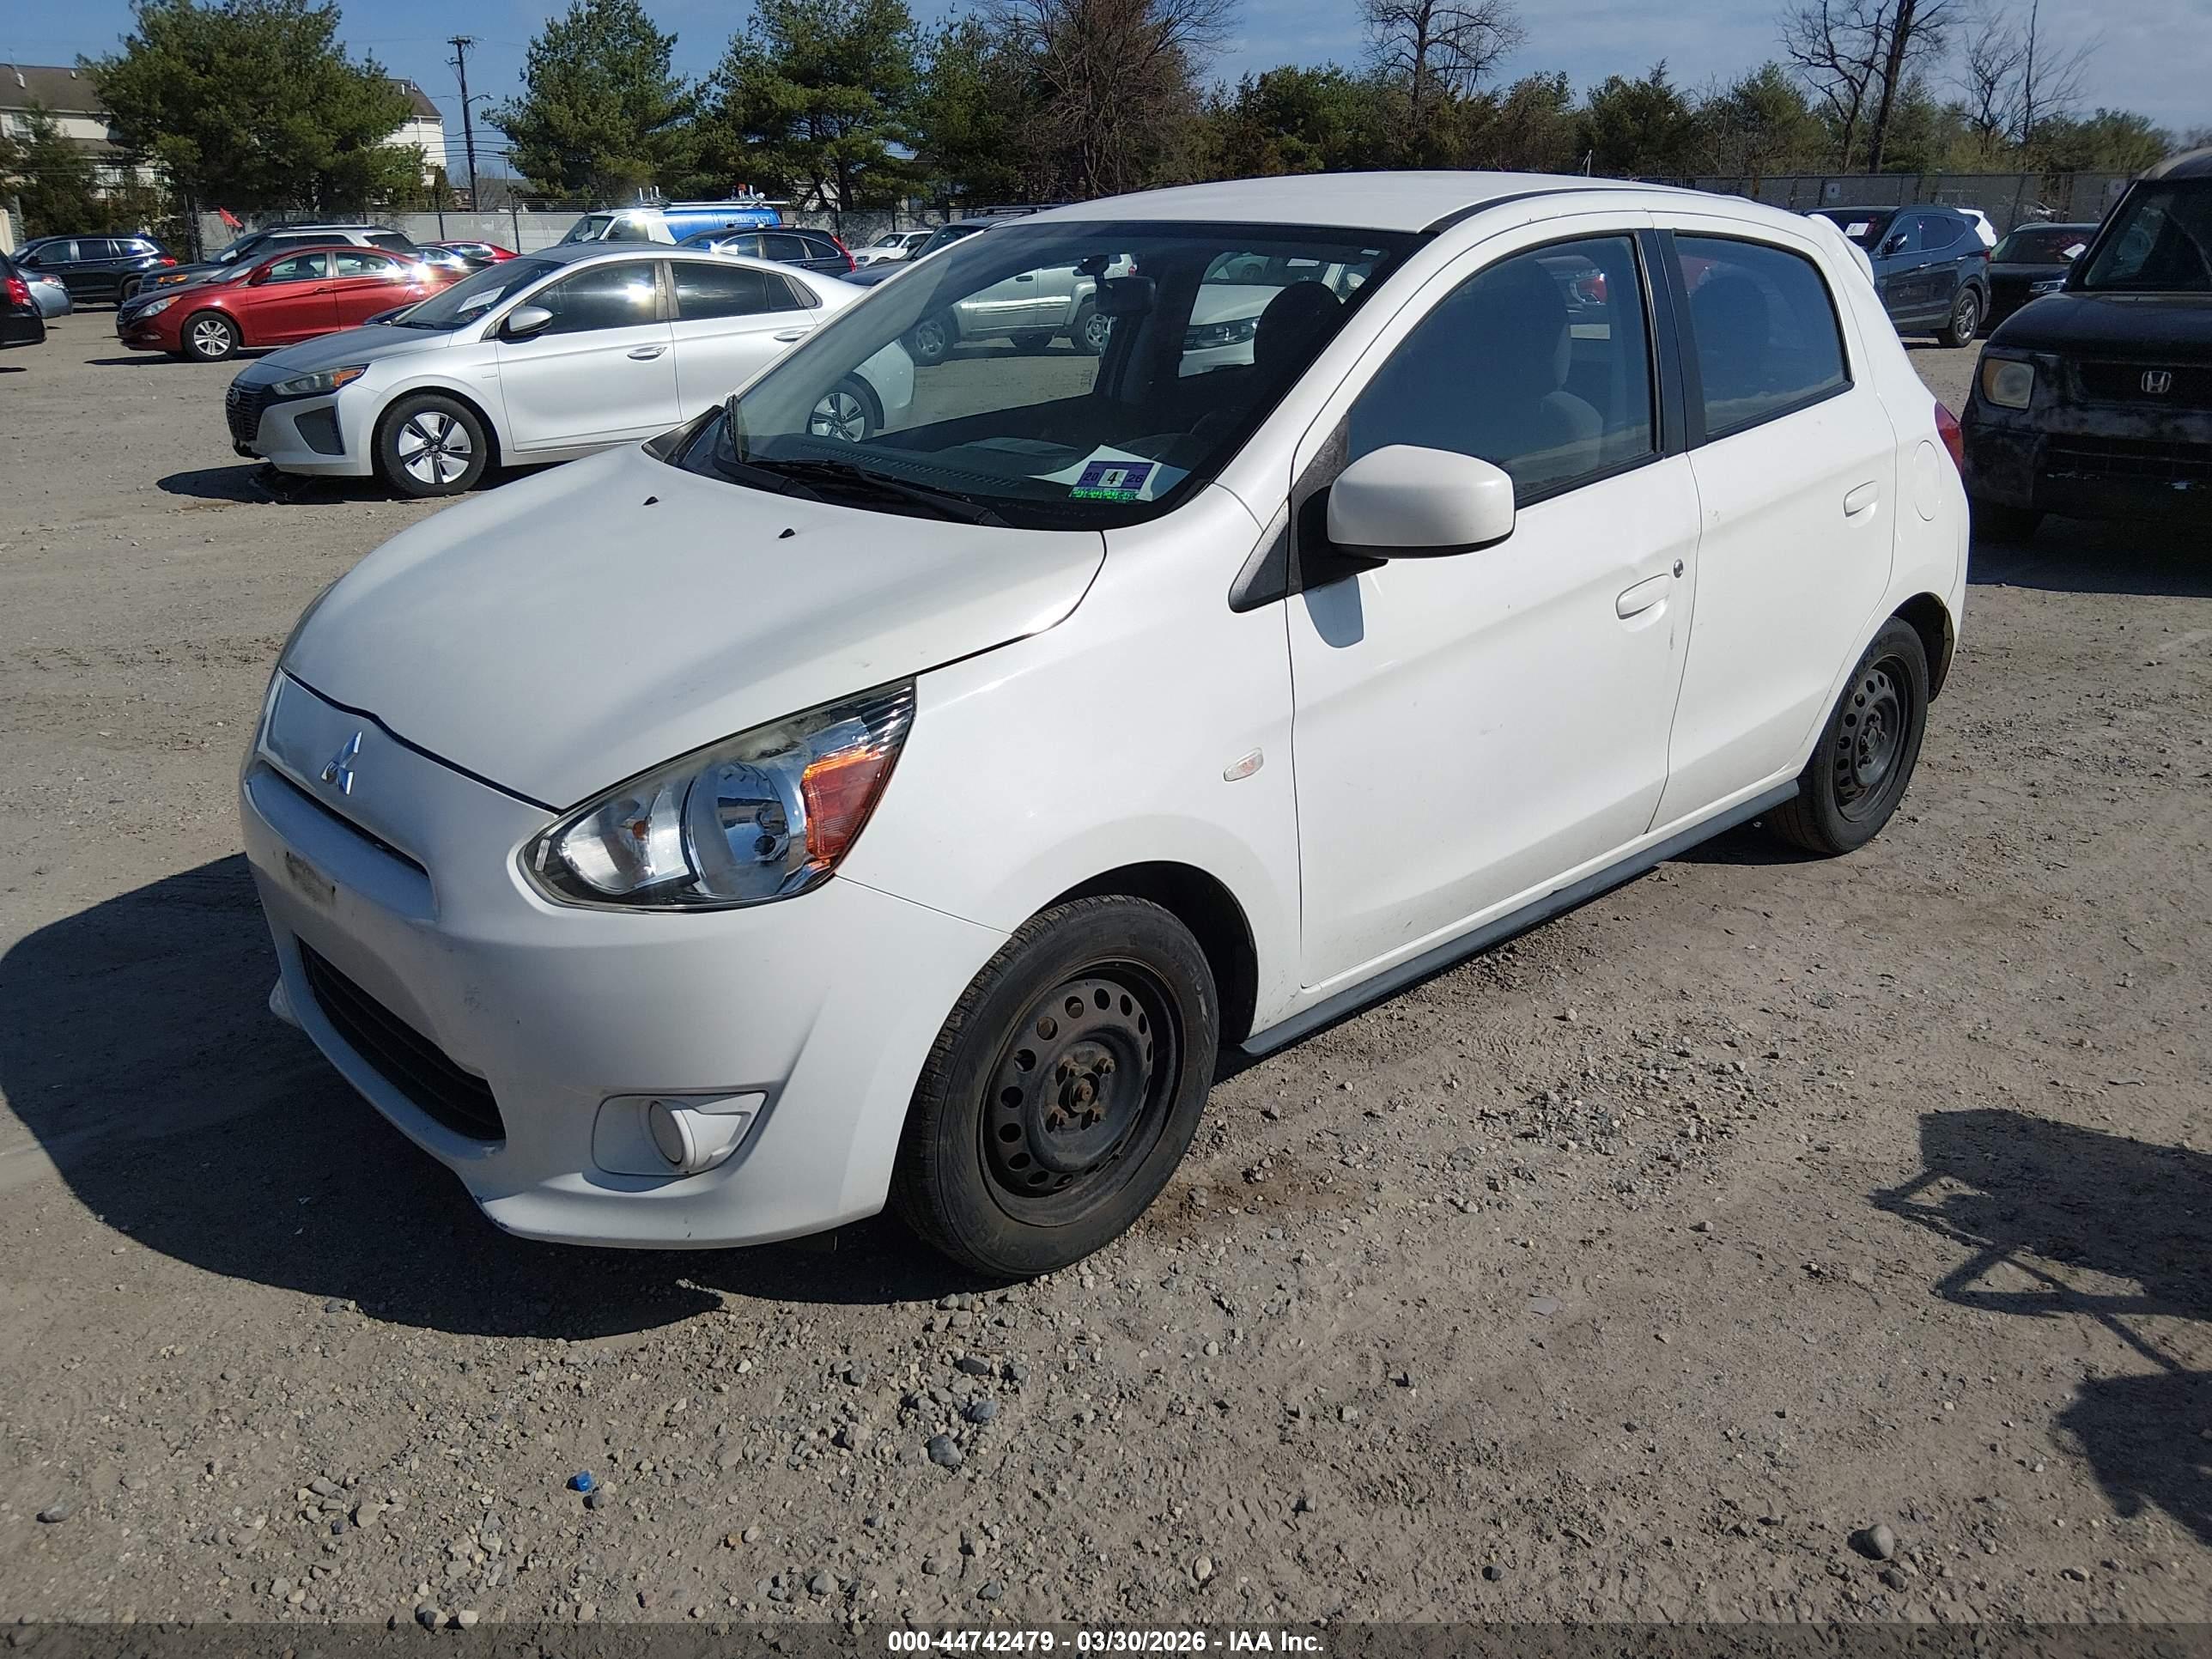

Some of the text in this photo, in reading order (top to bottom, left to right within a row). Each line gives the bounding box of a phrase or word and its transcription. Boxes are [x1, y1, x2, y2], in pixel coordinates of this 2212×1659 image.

[726, 216, 770, 225] COMCAST
[1084, 471, 1144, 484] 20 4 26
